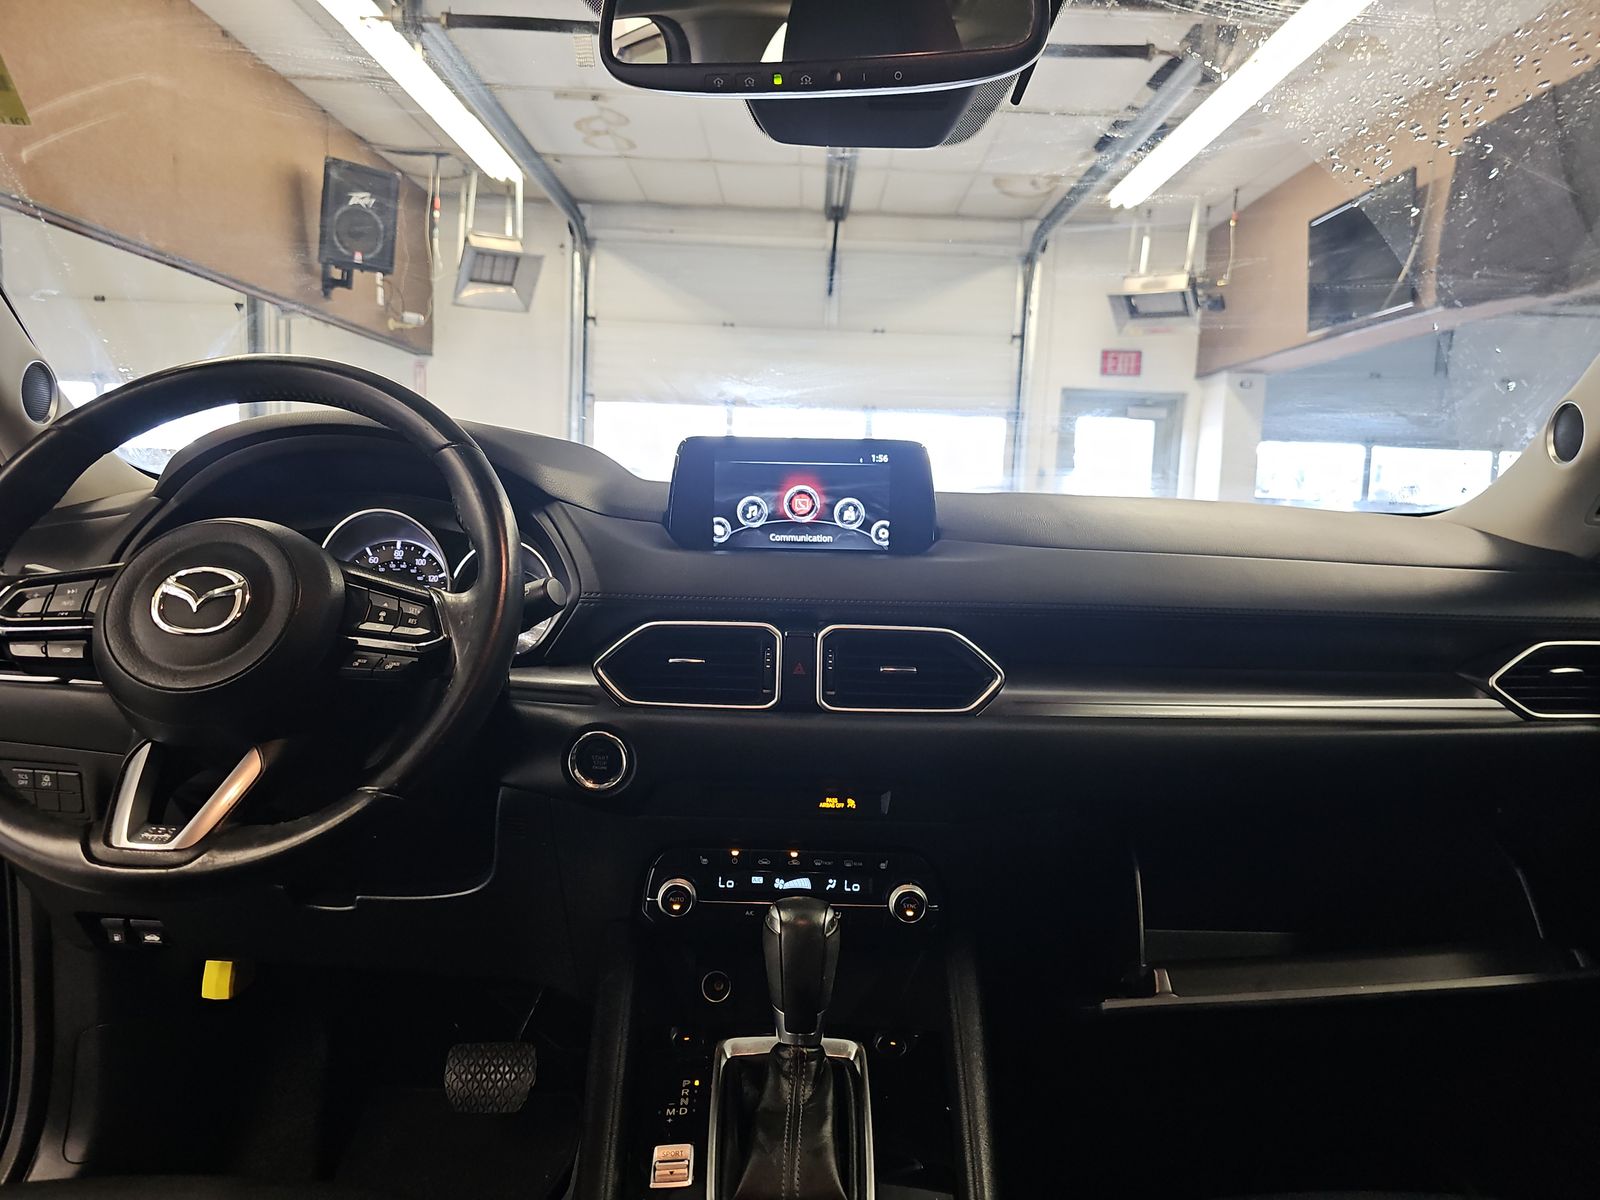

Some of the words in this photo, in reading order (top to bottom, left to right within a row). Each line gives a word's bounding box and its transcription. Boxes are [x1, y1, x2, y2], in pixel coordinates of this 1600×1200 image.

[871, 454, 889, 463] 1:56
[769, 533, 833, 543] Communication
[368, 556, 379, 564] 60
[415, 558, 427, 566] 100
[428, 575, 439, 583] 120
[682, 1080, 691, 1088] P
[681, 1088, 690, 1096] R
[680, 1097, 689, 1106] N
[665, 1108, 676, 1116] M
[679, 1107, 688, 1116] D
[662, 1150, 684, 1158] SPORT
